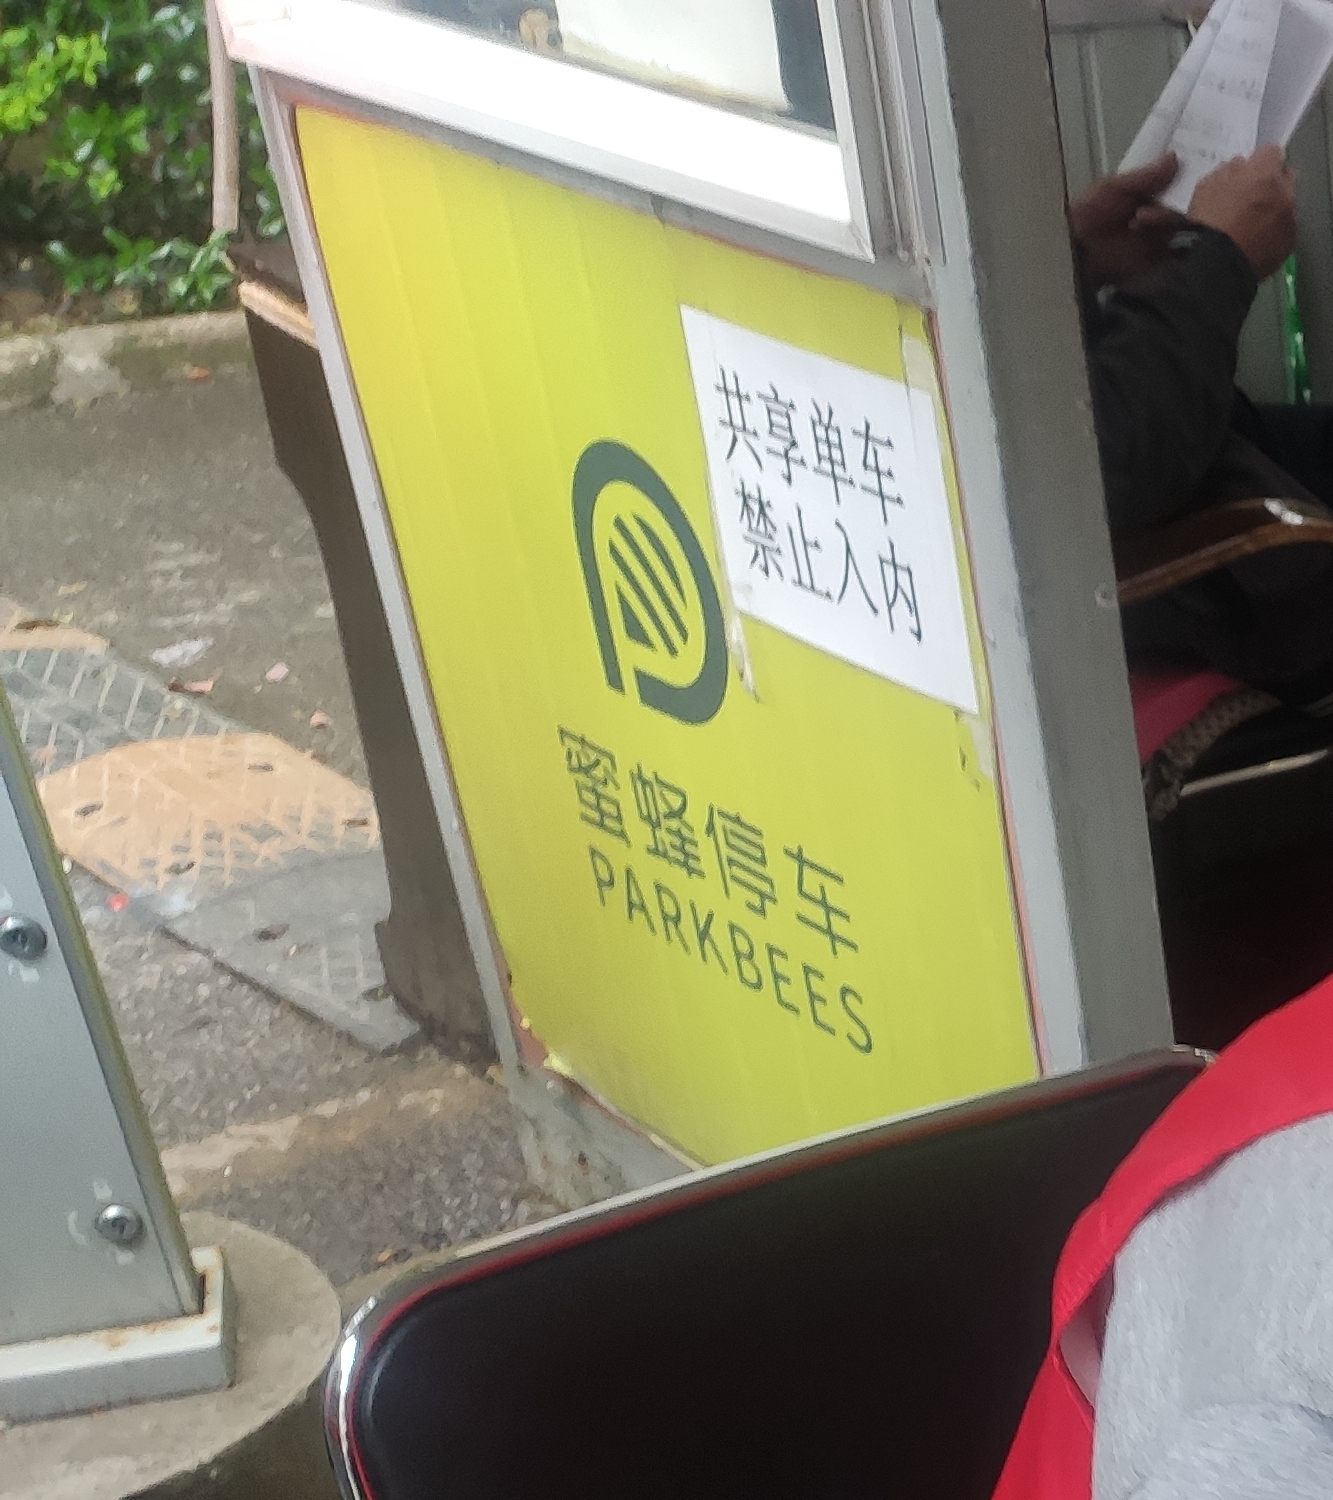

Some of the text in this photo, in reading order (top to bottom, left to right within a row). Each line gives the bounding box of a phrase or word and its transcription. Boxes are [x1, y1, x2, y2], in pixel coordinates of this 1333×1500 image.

[714, 374, 904, 527] 共享单车
[734, 484, 924, 645] 禁止入内
[556, 725, 859, 956] 蜜蜂停车
[588, 845, 874, 1056] PARKBEES
